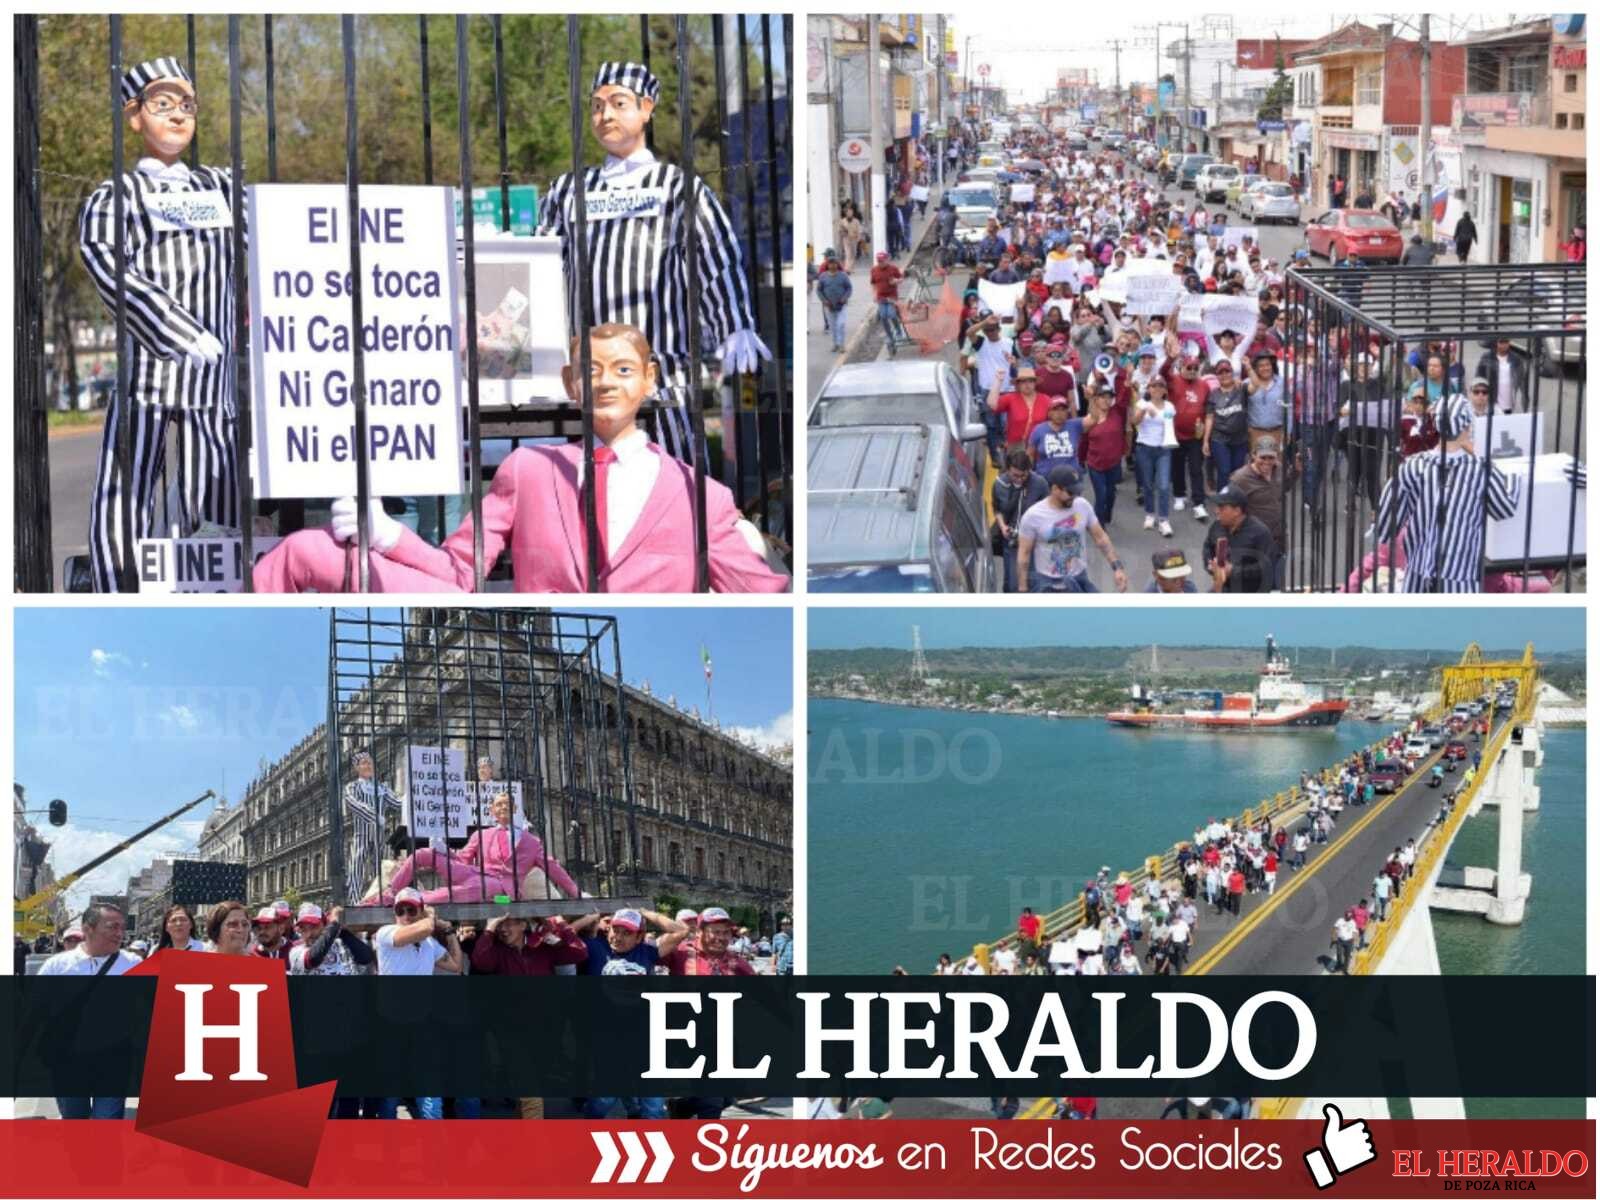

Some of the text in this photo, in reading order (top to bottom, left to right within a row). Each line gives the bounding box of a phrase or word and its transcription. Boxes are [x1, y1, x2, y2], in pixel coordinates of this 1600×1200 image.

[308, 207, 404, 243] El NE
[273, 270, 314, 298] no
[372, 264, 440, 298] toca
[263, 313, 452, 352] Ni Caderón
[279, 370, 441, 407] Ni Gnaro
[287, 424, 435, 462] Ni el PAN
[141, 544, 166, 582] El
[176, 543, 225, 582] INE
